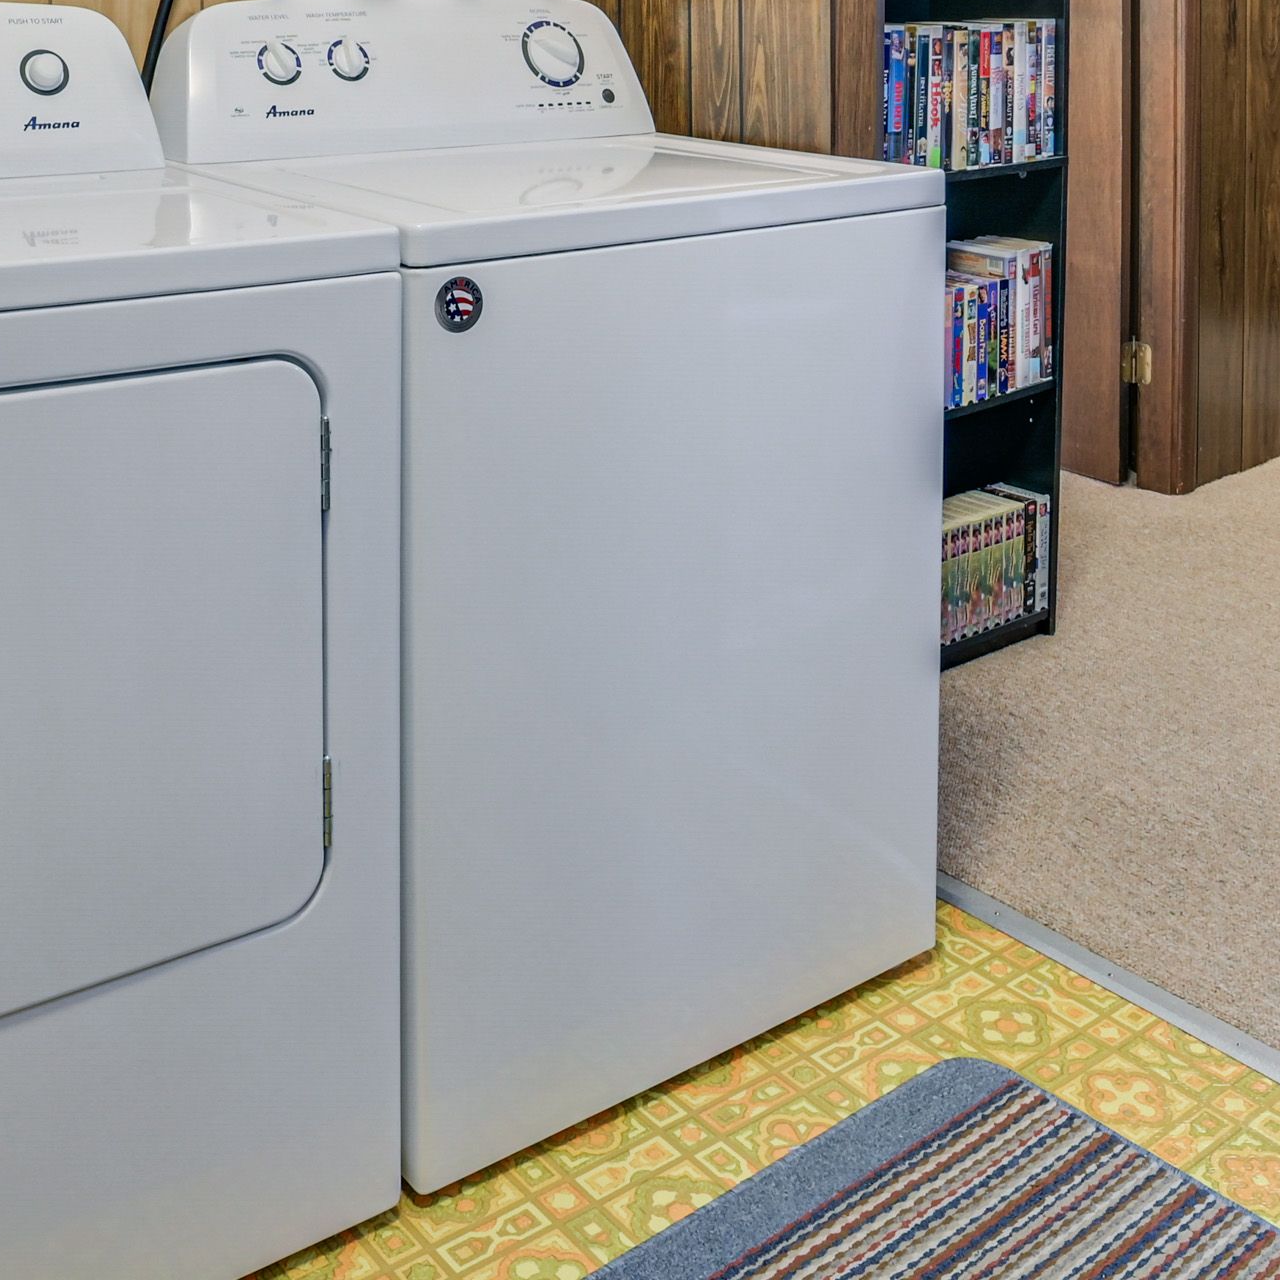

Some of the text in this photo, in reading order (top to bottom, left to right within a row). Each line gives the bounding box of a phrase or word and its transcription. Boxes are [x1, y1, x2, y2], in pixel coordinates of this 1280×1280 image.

[265, 105, 315, 119] Amana
[930, 82, 942, 130] Hook
[23, 116, 80, 131] Amana
[444, 279, 481, 304] AMERICA
